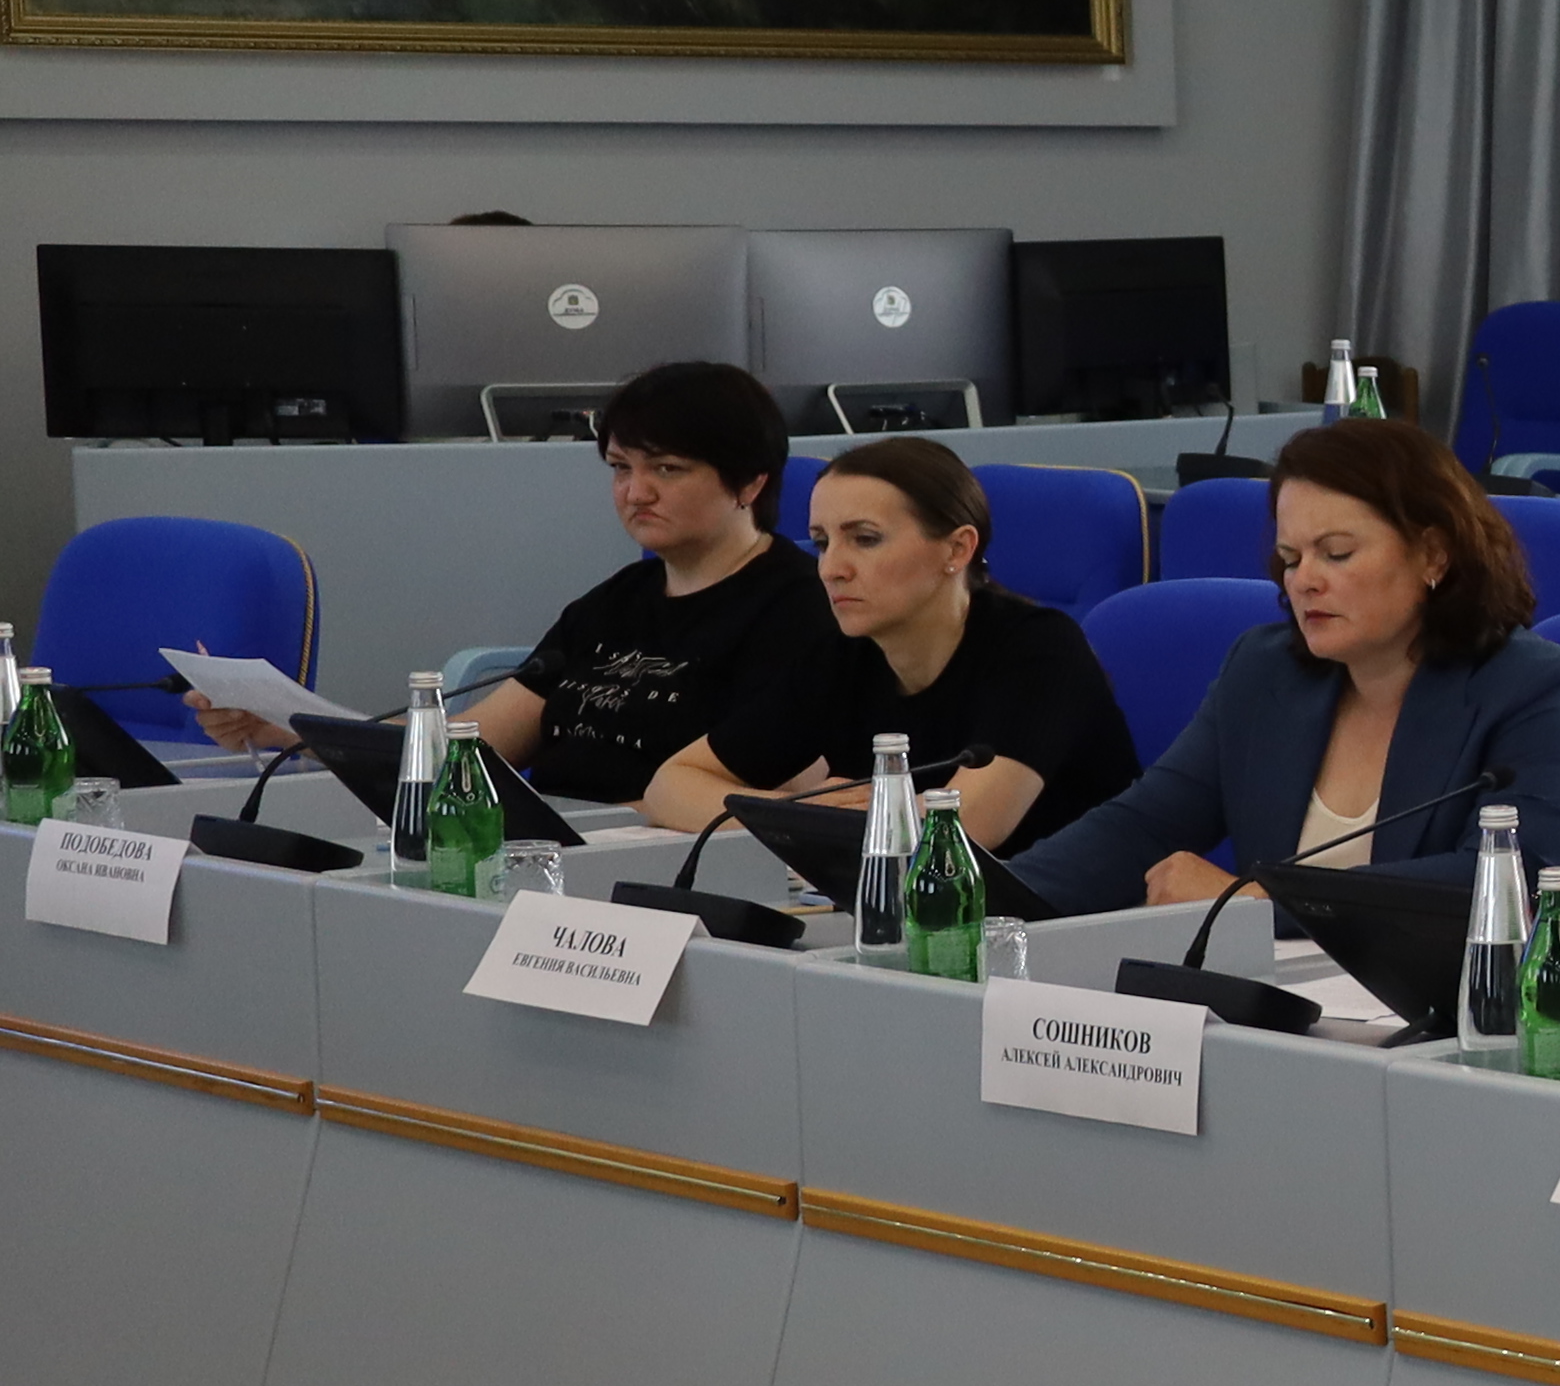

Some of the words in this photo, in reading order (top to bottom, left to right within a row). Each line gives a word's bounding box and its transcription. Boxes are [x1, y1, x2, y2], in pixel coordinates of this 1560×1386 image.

[59, 832, 153, 861] ПОДОБЕДОВА
[56, 859, 93, 876] ОКСАНА
[95, 864, 144, 883] ИВАНОВНА
[553, 926, 627, 957] ЧАЛОВА
[512, 952, 564, 973] ЕВГЕНИЯ
[565, 961, 642, 986] ВАСИЛЬЕВНА
[1033, 1017, 1151, 1054] СОШНИКОВ
[1001, 1047, 1060, 1069] АЛЕКСЕЙ
[1064, 1057, 1182, 1086] АЛЕКСАНДРОВИЧ
